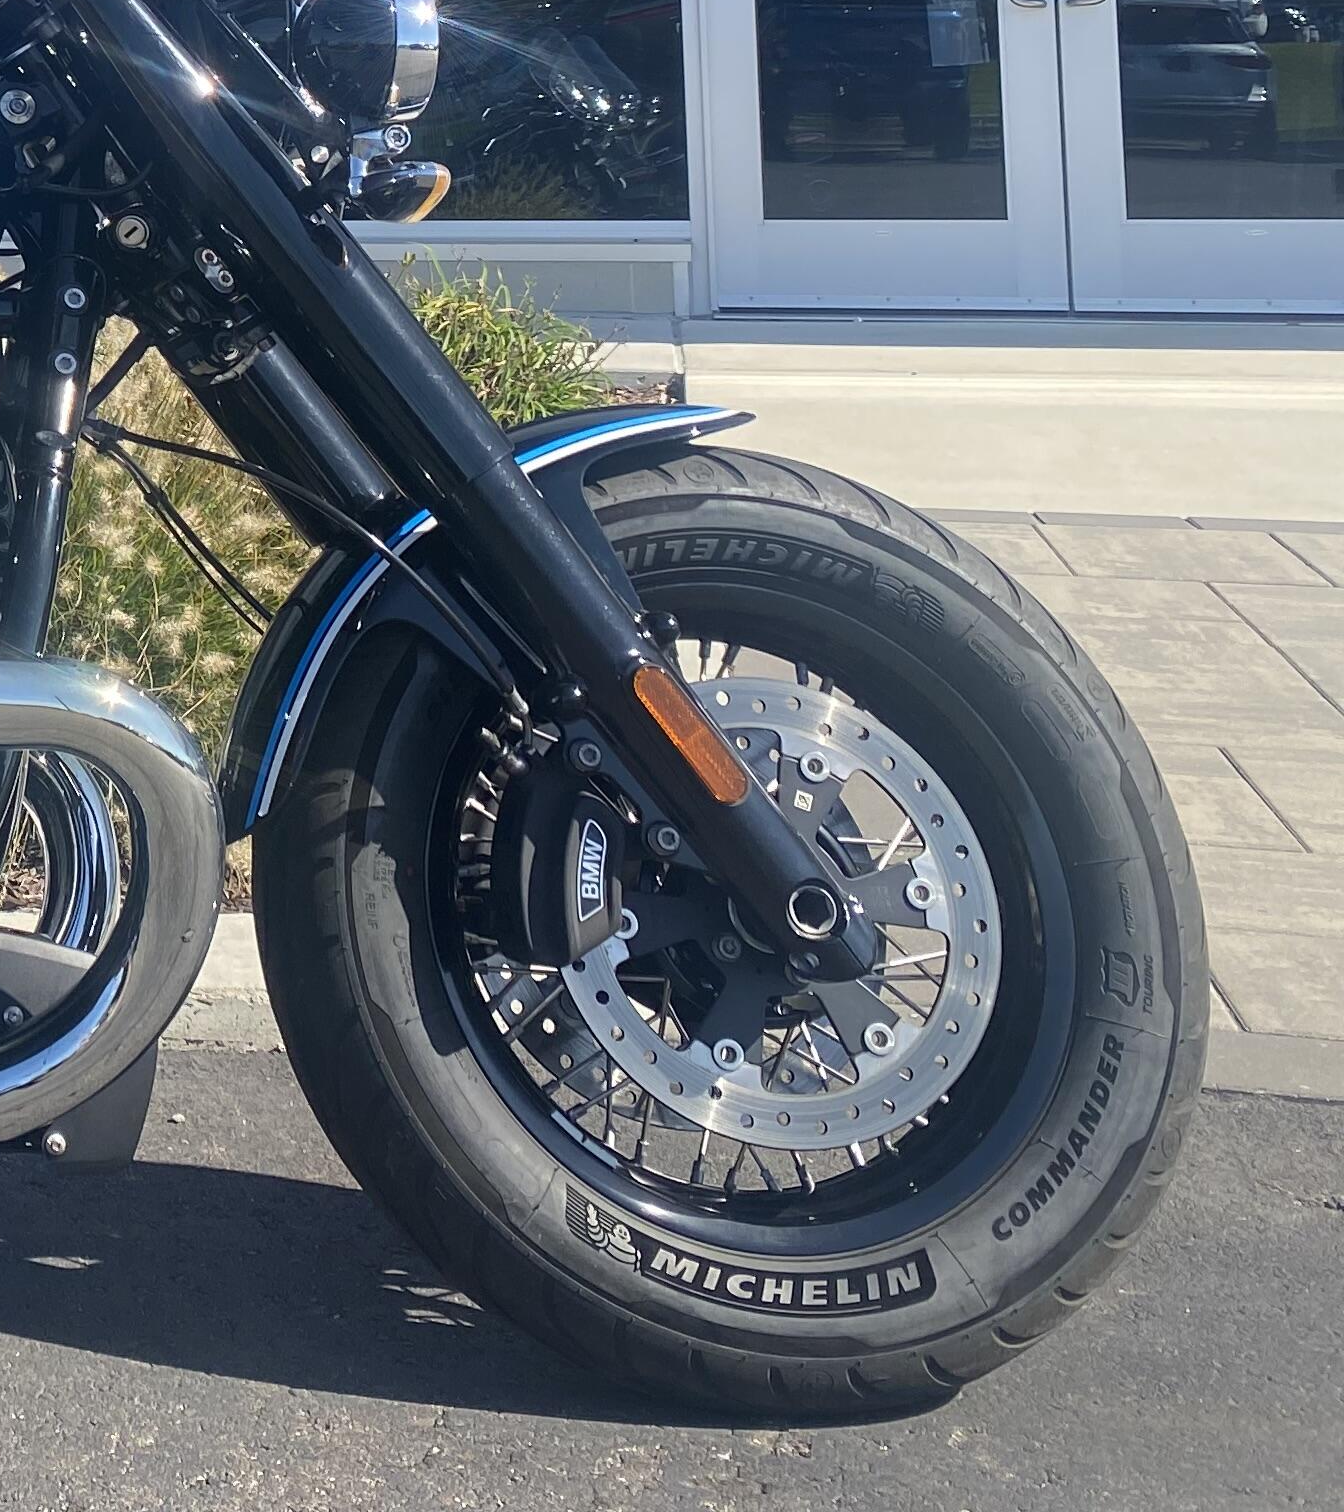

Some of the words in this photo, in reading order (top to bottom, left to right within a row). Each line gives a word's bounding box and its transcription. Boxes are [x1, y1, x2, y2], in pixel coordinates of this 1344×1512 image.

[615, 538, 862, 584] MICHELIN
[581, 837, 603, 900] BMW
[1142, 954, 1154, 1015] TOURING
[992, 1034, 1125, 1241] COMMANDER
[650, 1248, 923, 1306] MICHELIN
